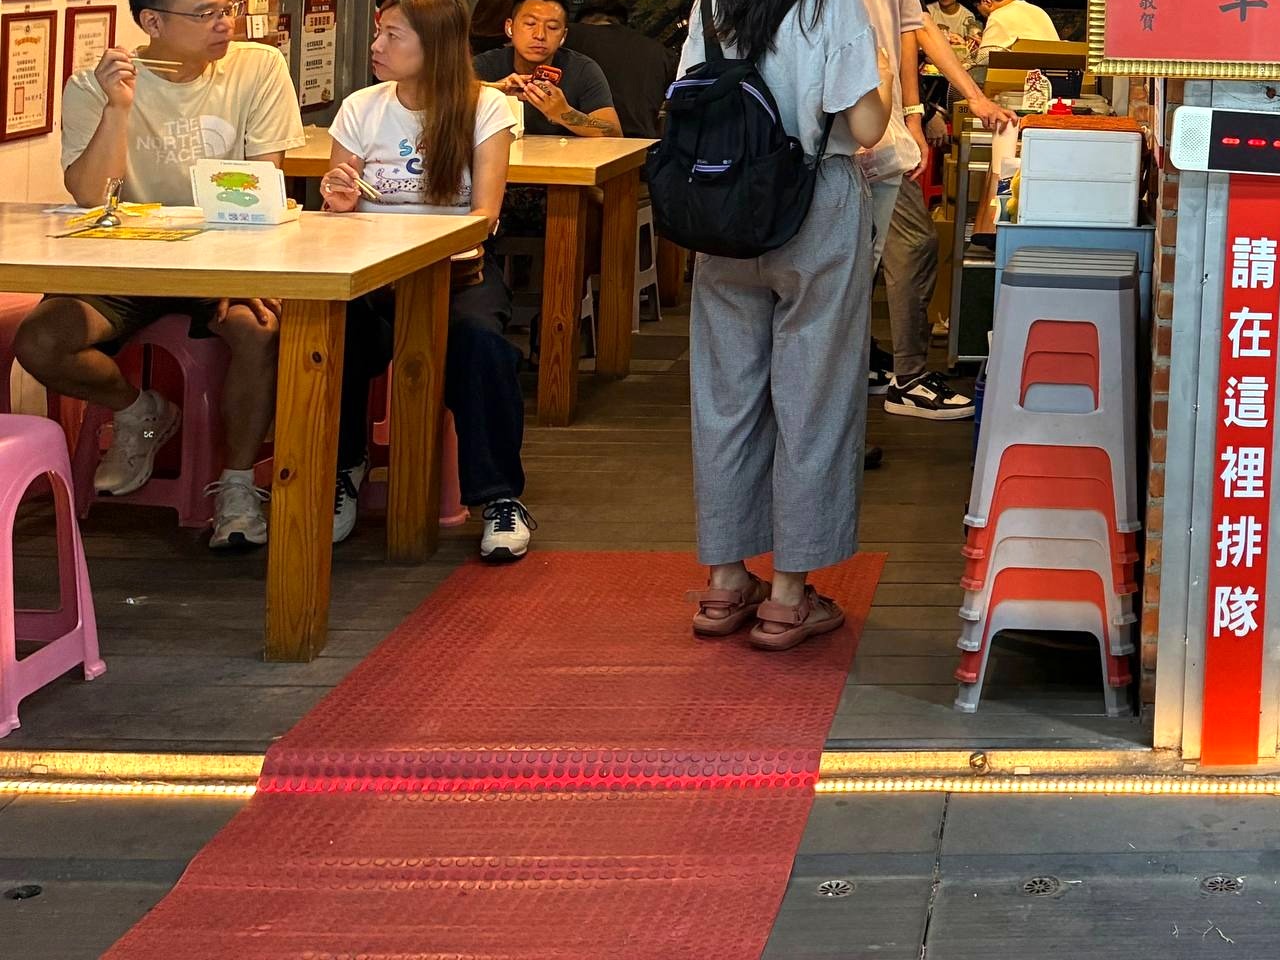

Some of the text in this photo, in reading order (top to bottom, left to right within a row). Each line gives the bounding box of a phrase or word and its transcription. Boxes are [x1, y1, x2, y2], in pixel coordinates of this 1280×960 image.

[163, 118, 199, 135] THE
[156, 145, 202, 164] FACE
[1212, 236, 1277, 639] 請在這裡排隊
